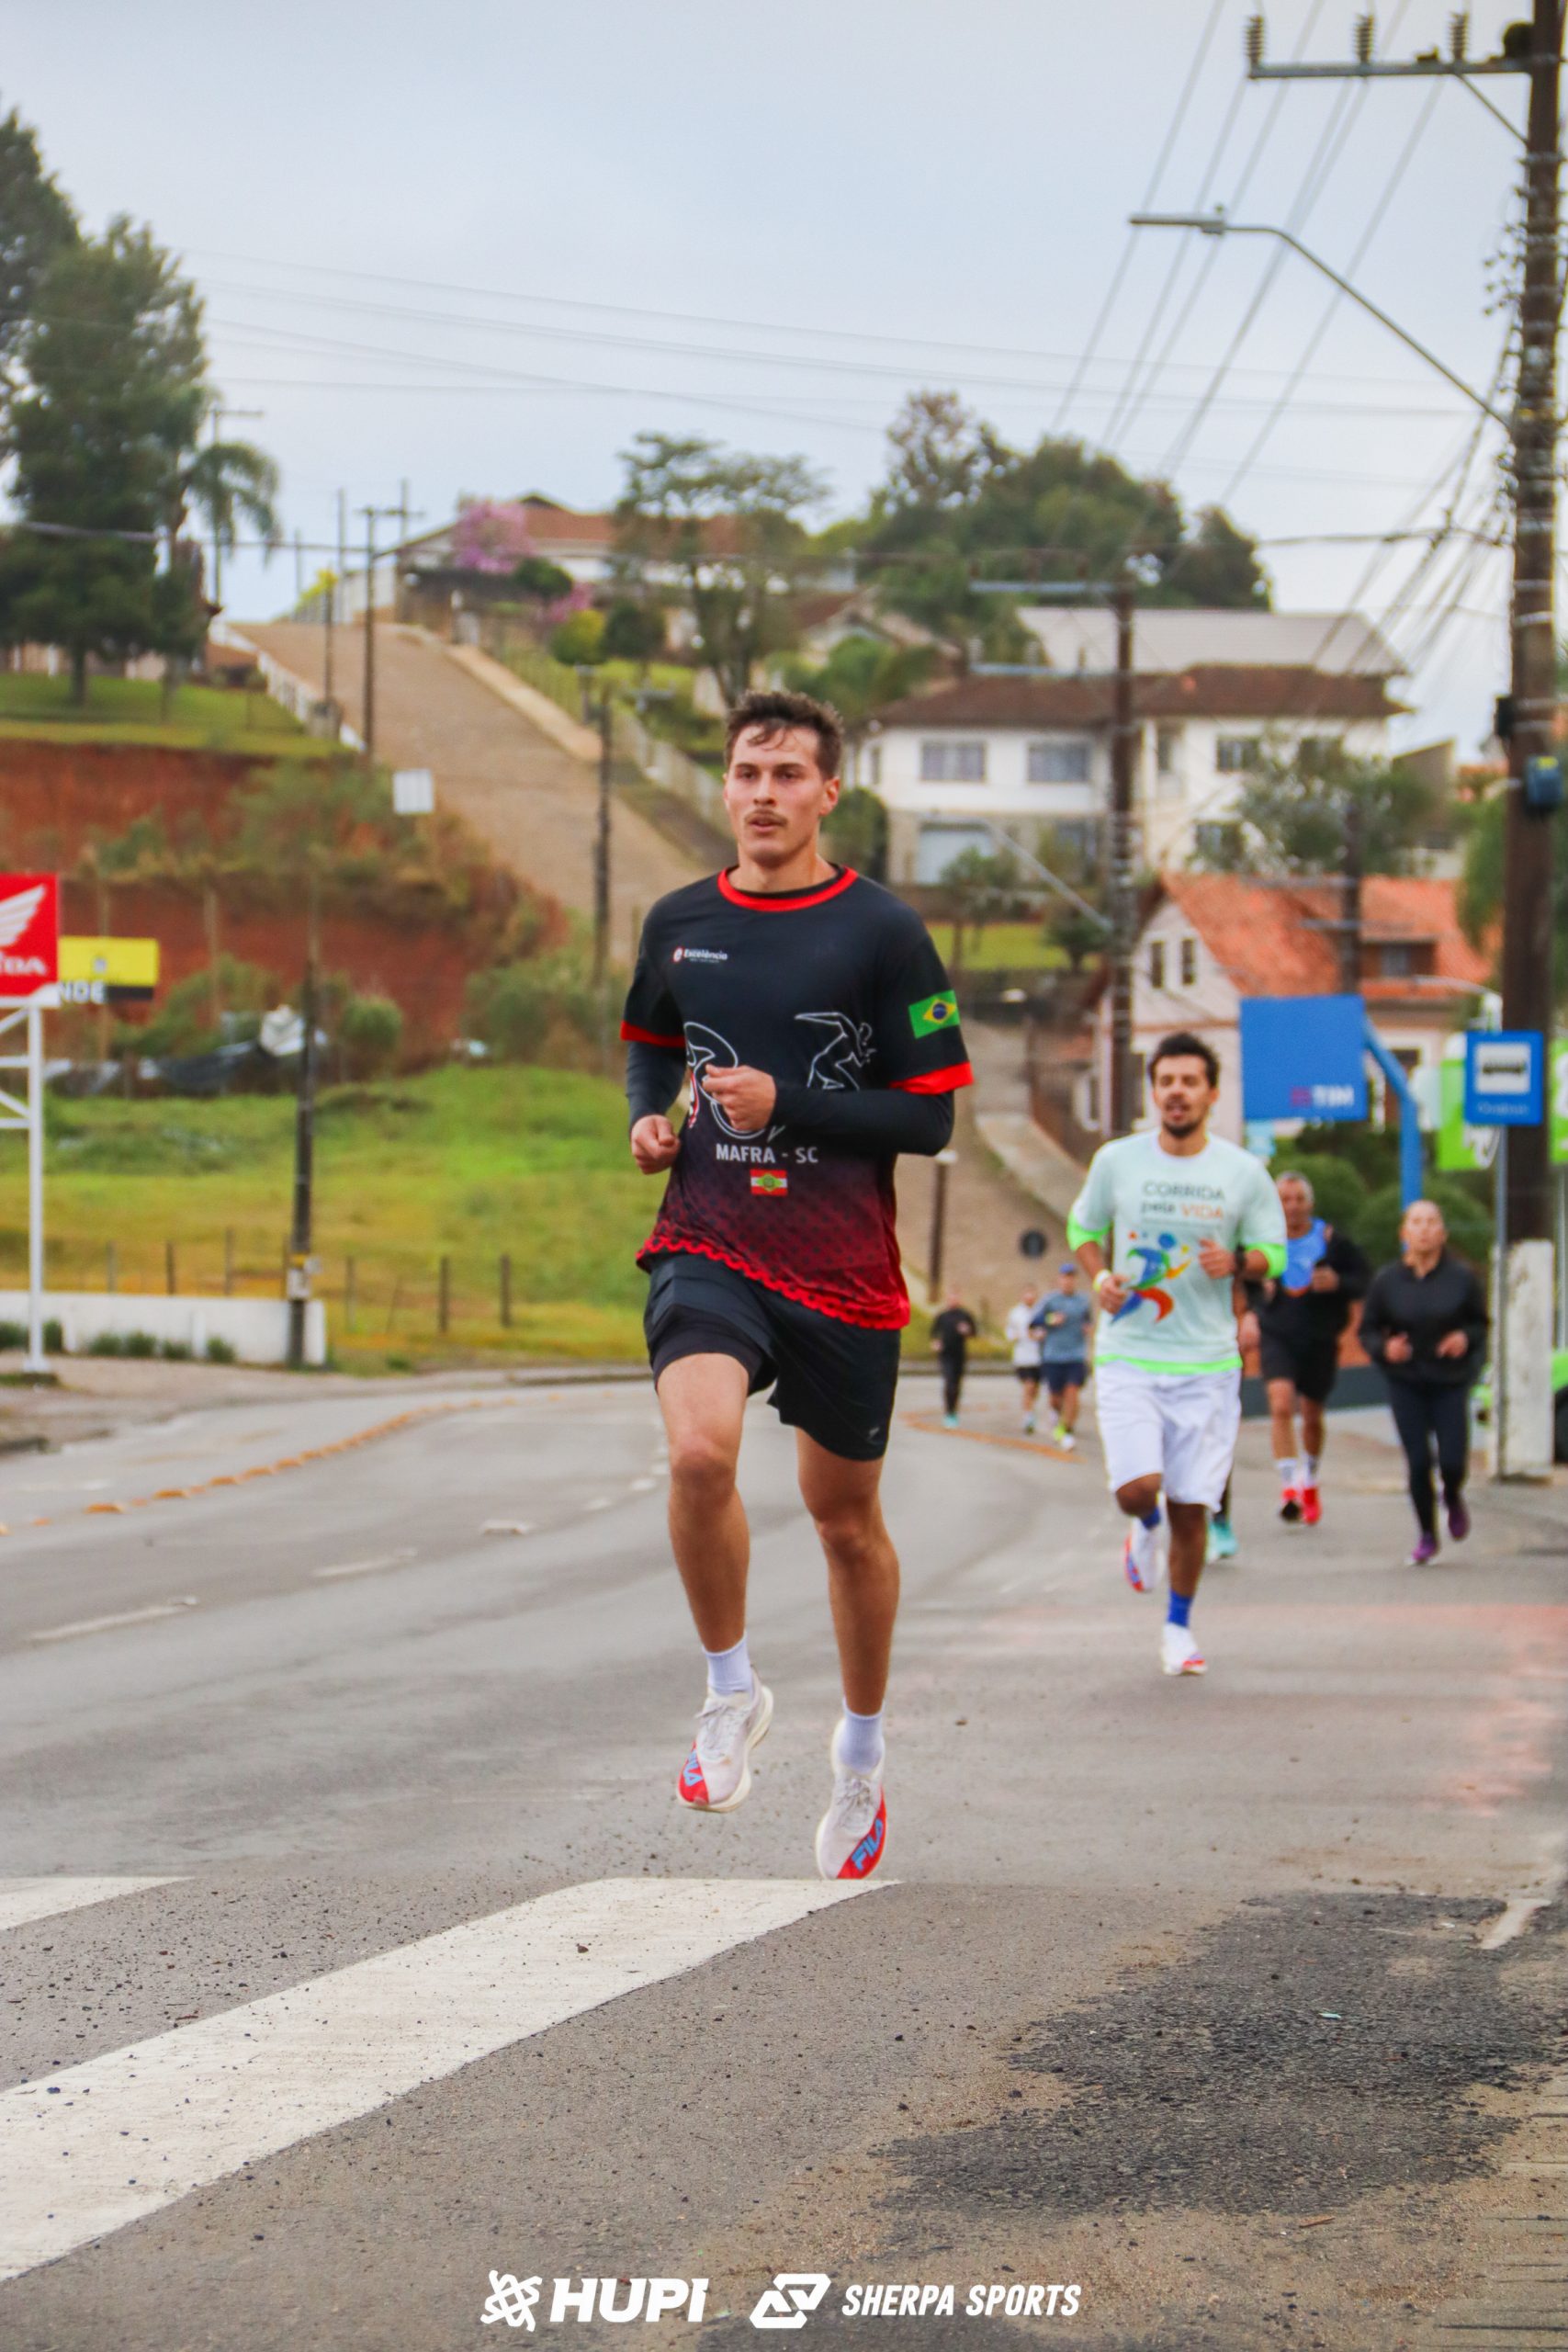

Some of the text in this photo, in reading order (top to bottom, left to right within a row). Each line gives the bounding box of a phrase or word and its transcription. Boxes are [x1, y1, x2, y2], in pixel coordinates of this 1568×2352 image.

[716, 1144, 776, 1163] MAFRA
[795, 1148, 818, 1164] SC
[1142, 1180, 1226, 1200] CORRIDA
[1180, 1203, 1224, 1220] VIDA
